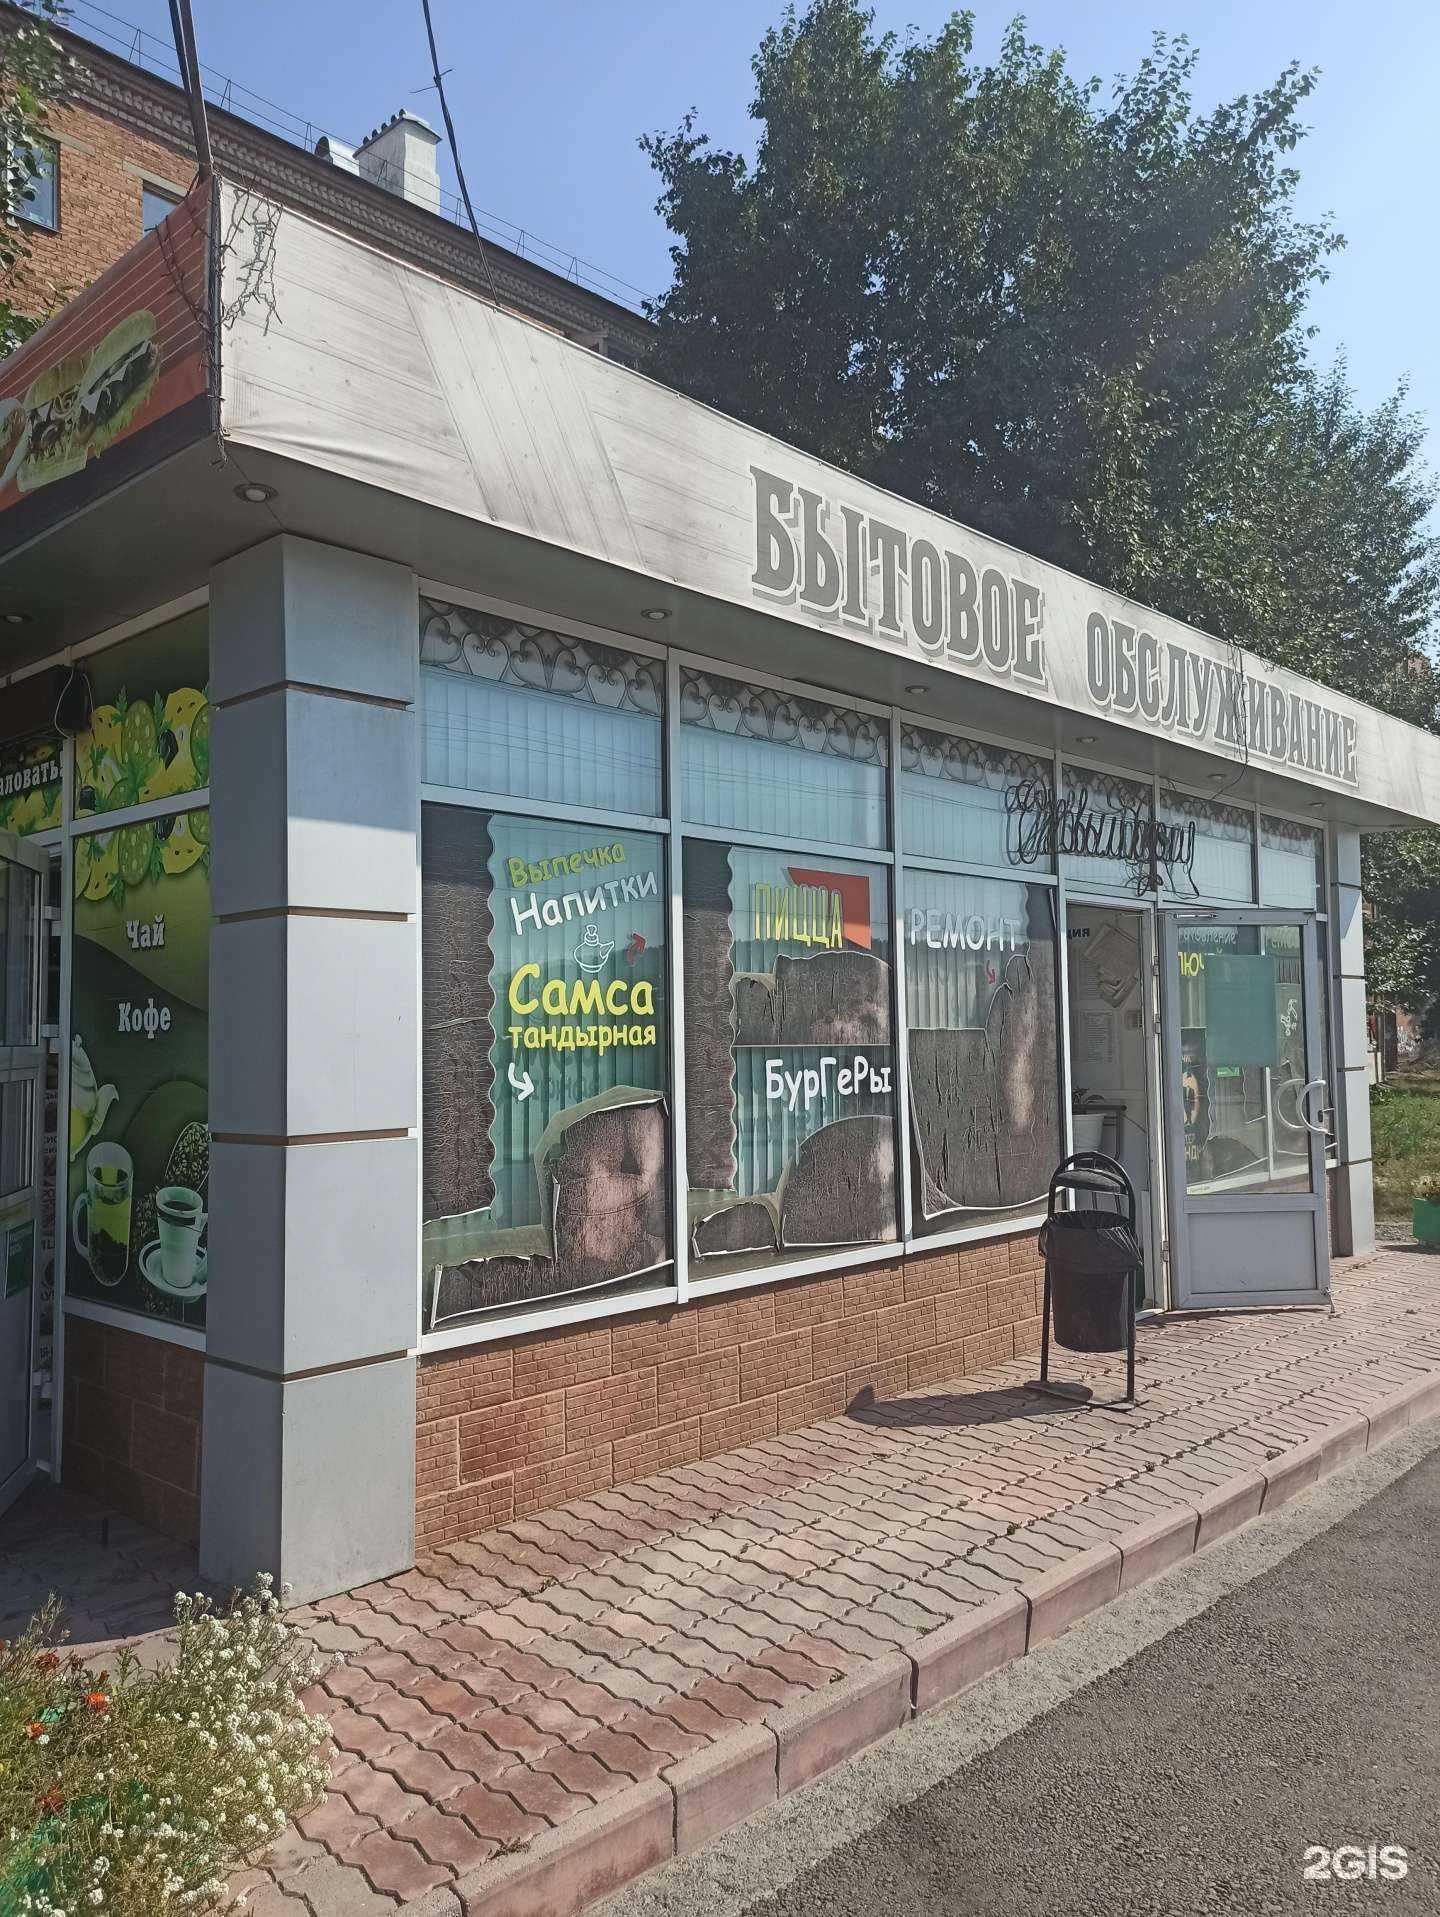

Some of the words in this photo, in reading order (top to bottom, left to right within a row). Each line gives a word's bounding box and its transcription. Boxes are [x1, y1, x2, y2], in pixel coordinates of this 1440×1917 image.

[750, 466, 1048, 692] БЫТОВОЕ
[1086, 612, 1358, 788] ОБСЛУЖИВАНИЕ
[0, 751, 64, 796] аловать!
[507, 841, 626, 888] Выпечка
[510, 871, 659, 935] Напитки
[754, 882, 844, 948] ПИЦЦА
[126, 914, 165, 950] Чай
[909, 907, 1021, 952] РЕМОНТ
[508, 962, 655, 1016] Самса
[117, 998, 172, 1040] Кофе
[507, 1024, 657, 1056] тандырная
